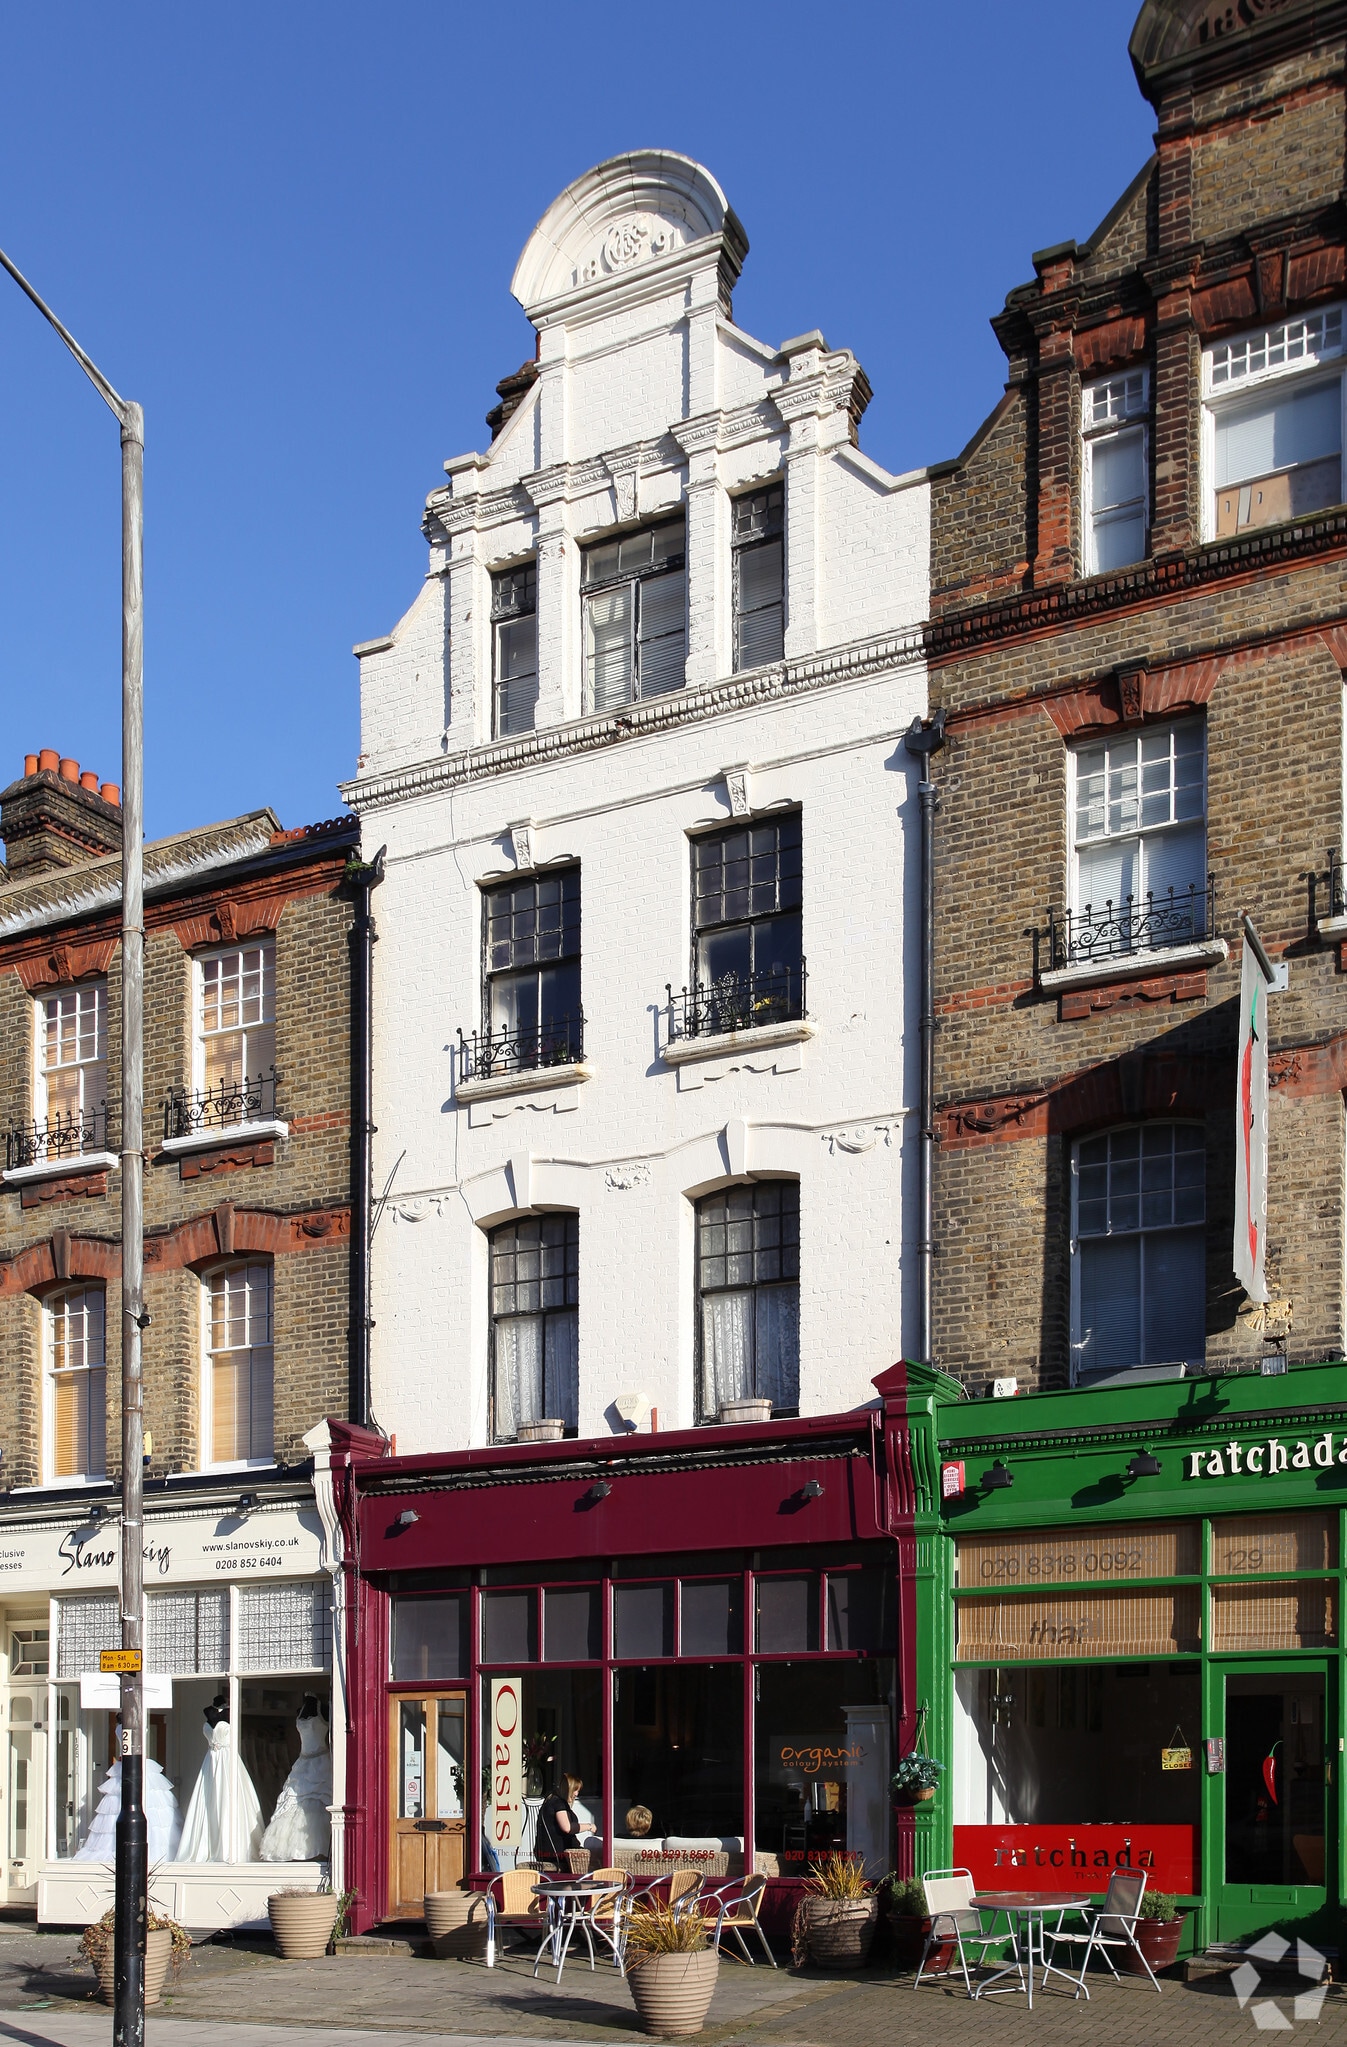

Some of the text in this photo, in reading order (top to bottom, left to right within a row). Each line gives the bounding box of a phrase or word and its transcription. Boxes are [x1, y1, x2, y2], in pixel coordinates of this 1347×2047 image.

[202, 1537, 299, 1552] www.slanovskiy.co.uk
[215, 1556, 282, 1570] 0208 852 6404
[981, 1551, 1142, 1578] 020 8318 0092
[1223, 1549, 1264, 1571] 129
[496, 1684, 518, 1842] Oasis
[780, 1742, 868, 1773] organic
[641, 1849, 660, 1859] 020
[784, 1851, 804, 1861] 020
[993, 1838, 1156, 1868] ratchada
